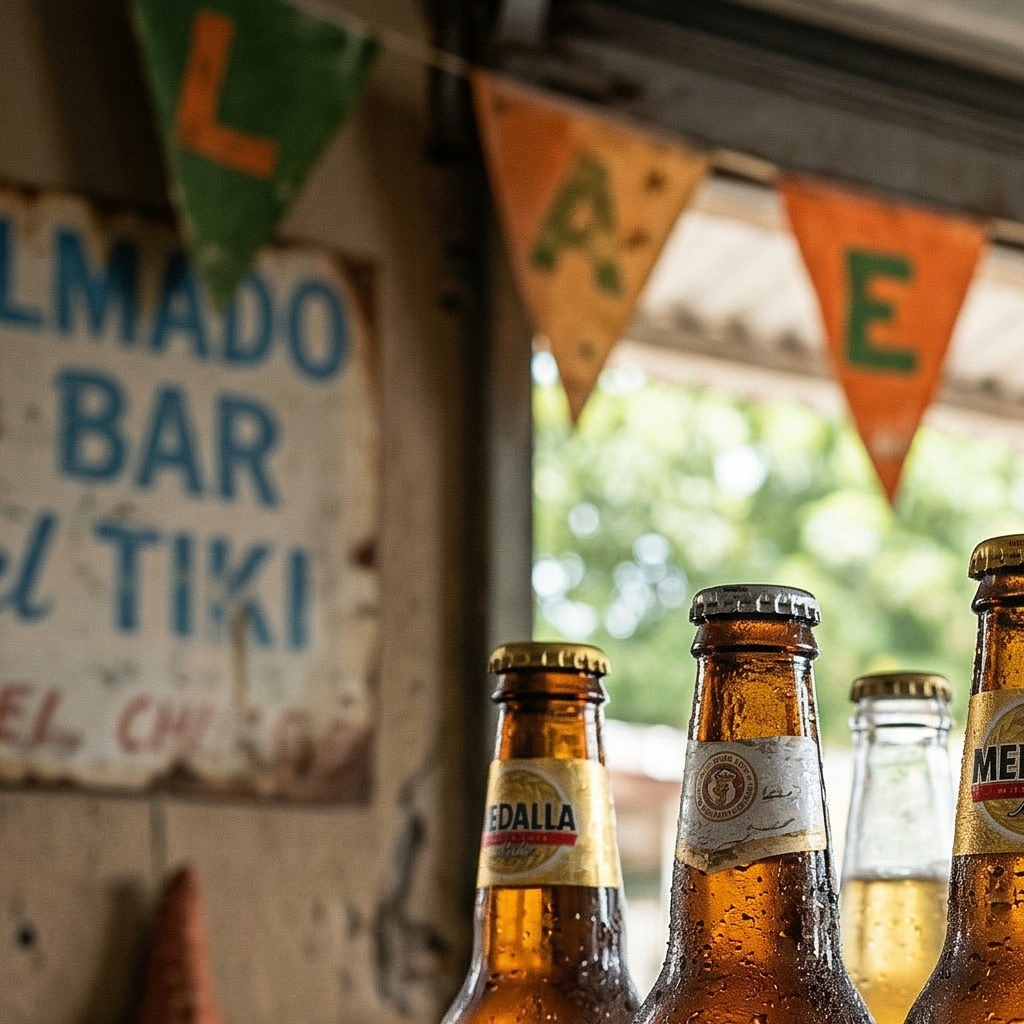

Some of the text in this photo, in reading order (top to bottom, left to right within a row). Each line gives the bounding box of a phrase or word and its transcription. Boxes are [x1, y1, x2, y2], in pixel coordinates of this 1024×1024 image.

[175, 12, 278, 178] L
[531, 150, 625, 297] A
[843, 249, 918, 376] E
[55, 369, 281, 509] BAR
[94, 519, 311, 652] TIKI
